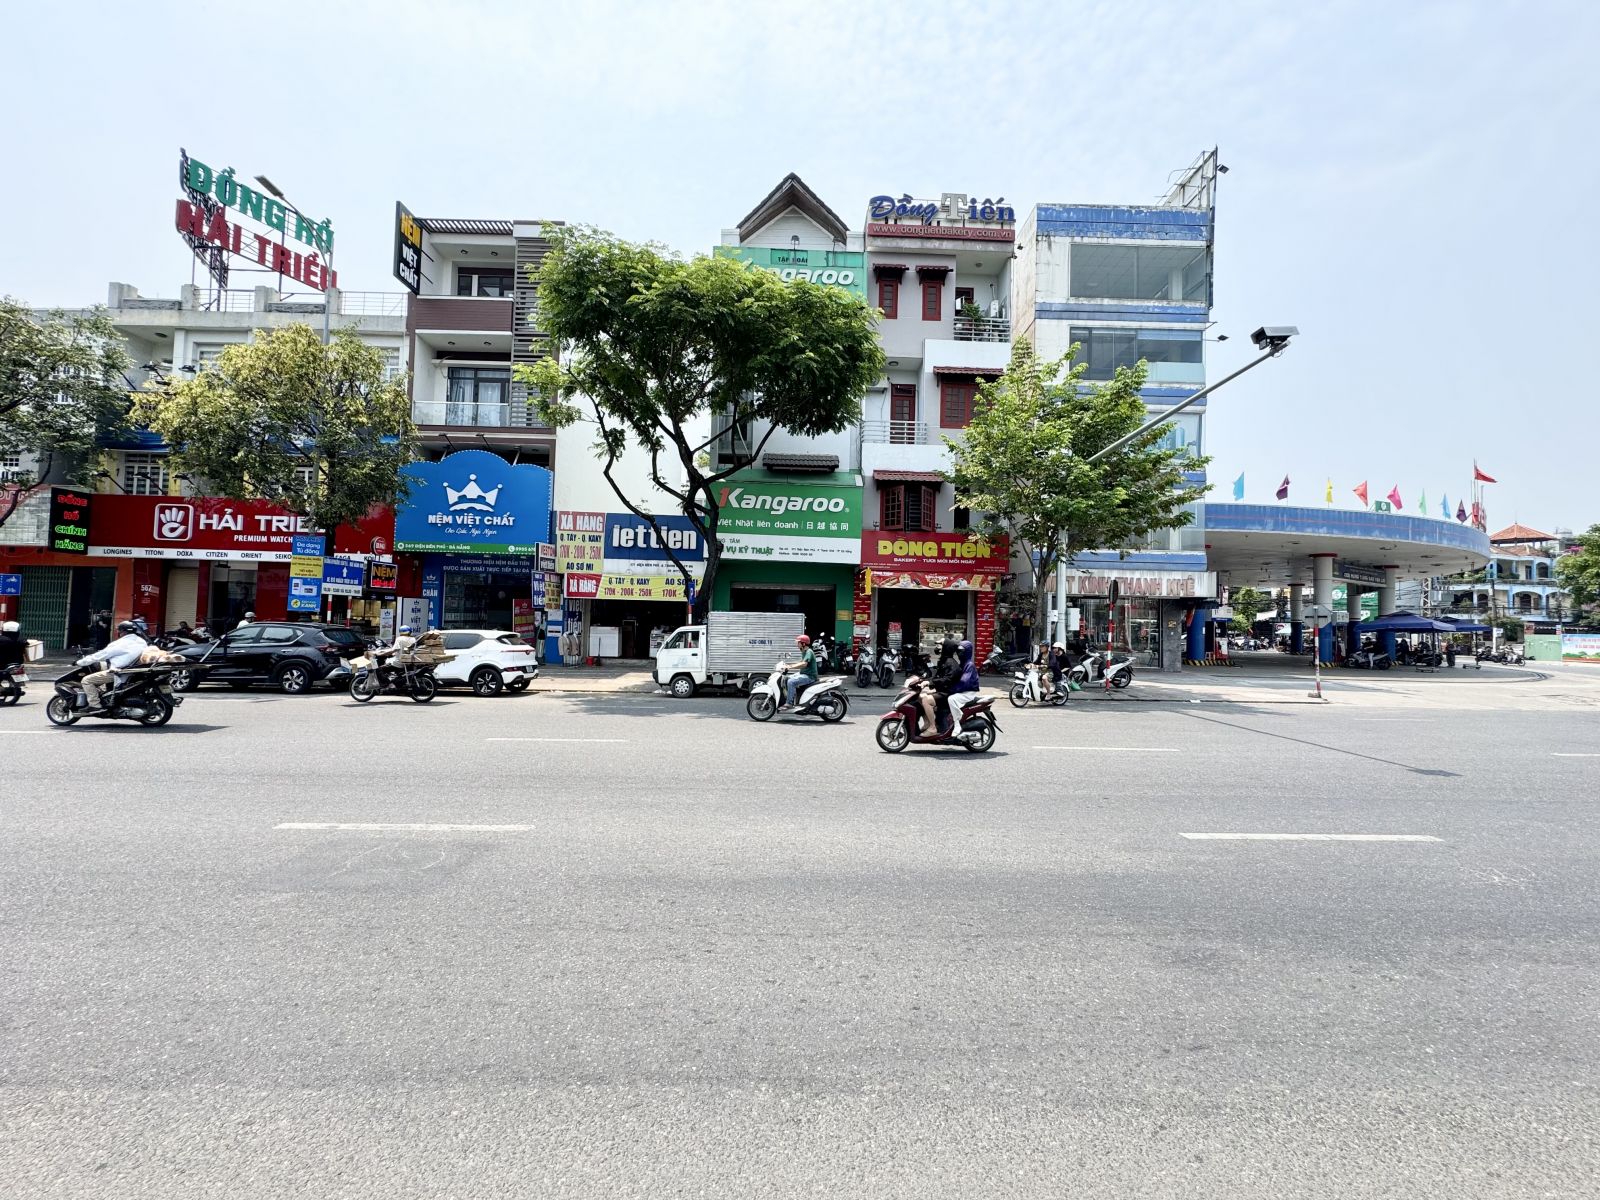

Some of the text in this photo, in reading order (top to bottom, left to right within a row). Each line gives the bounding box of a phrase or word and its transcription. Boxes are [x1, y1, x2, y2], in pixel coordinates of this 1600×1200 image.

[870, 193, 1016, 224] Đồng Tiến
[175, 198, 242, 254] HẢI
[199, 508, 244, 531] HẢI
[428, 512, 453, 527] NỆM
[484, 512, 516, 526] CHẤT
[560, 511, 603, 531] XẢ HÀNG
[735, 519, 754, 528] Nhật
[756, 520, 771, 528] liên
[774, 520, 799, 529] doanh
[234, 535, 267, 543] PREMIUM
[726, 546, 736, 555] VỤ
[738, 545, 748, 554] KỸ
[751, 546, 774, 556] THUẬT
[373, 564, 396, 579] NỆM
[586, 563, 594, 571] MI
[569, 576, 577, 593] XẢ
[578, 577, 597, 593] HÀNG
[1115, 576, 1163, 595] THANH
[1167, 574, 1195, 597] KHÊ
